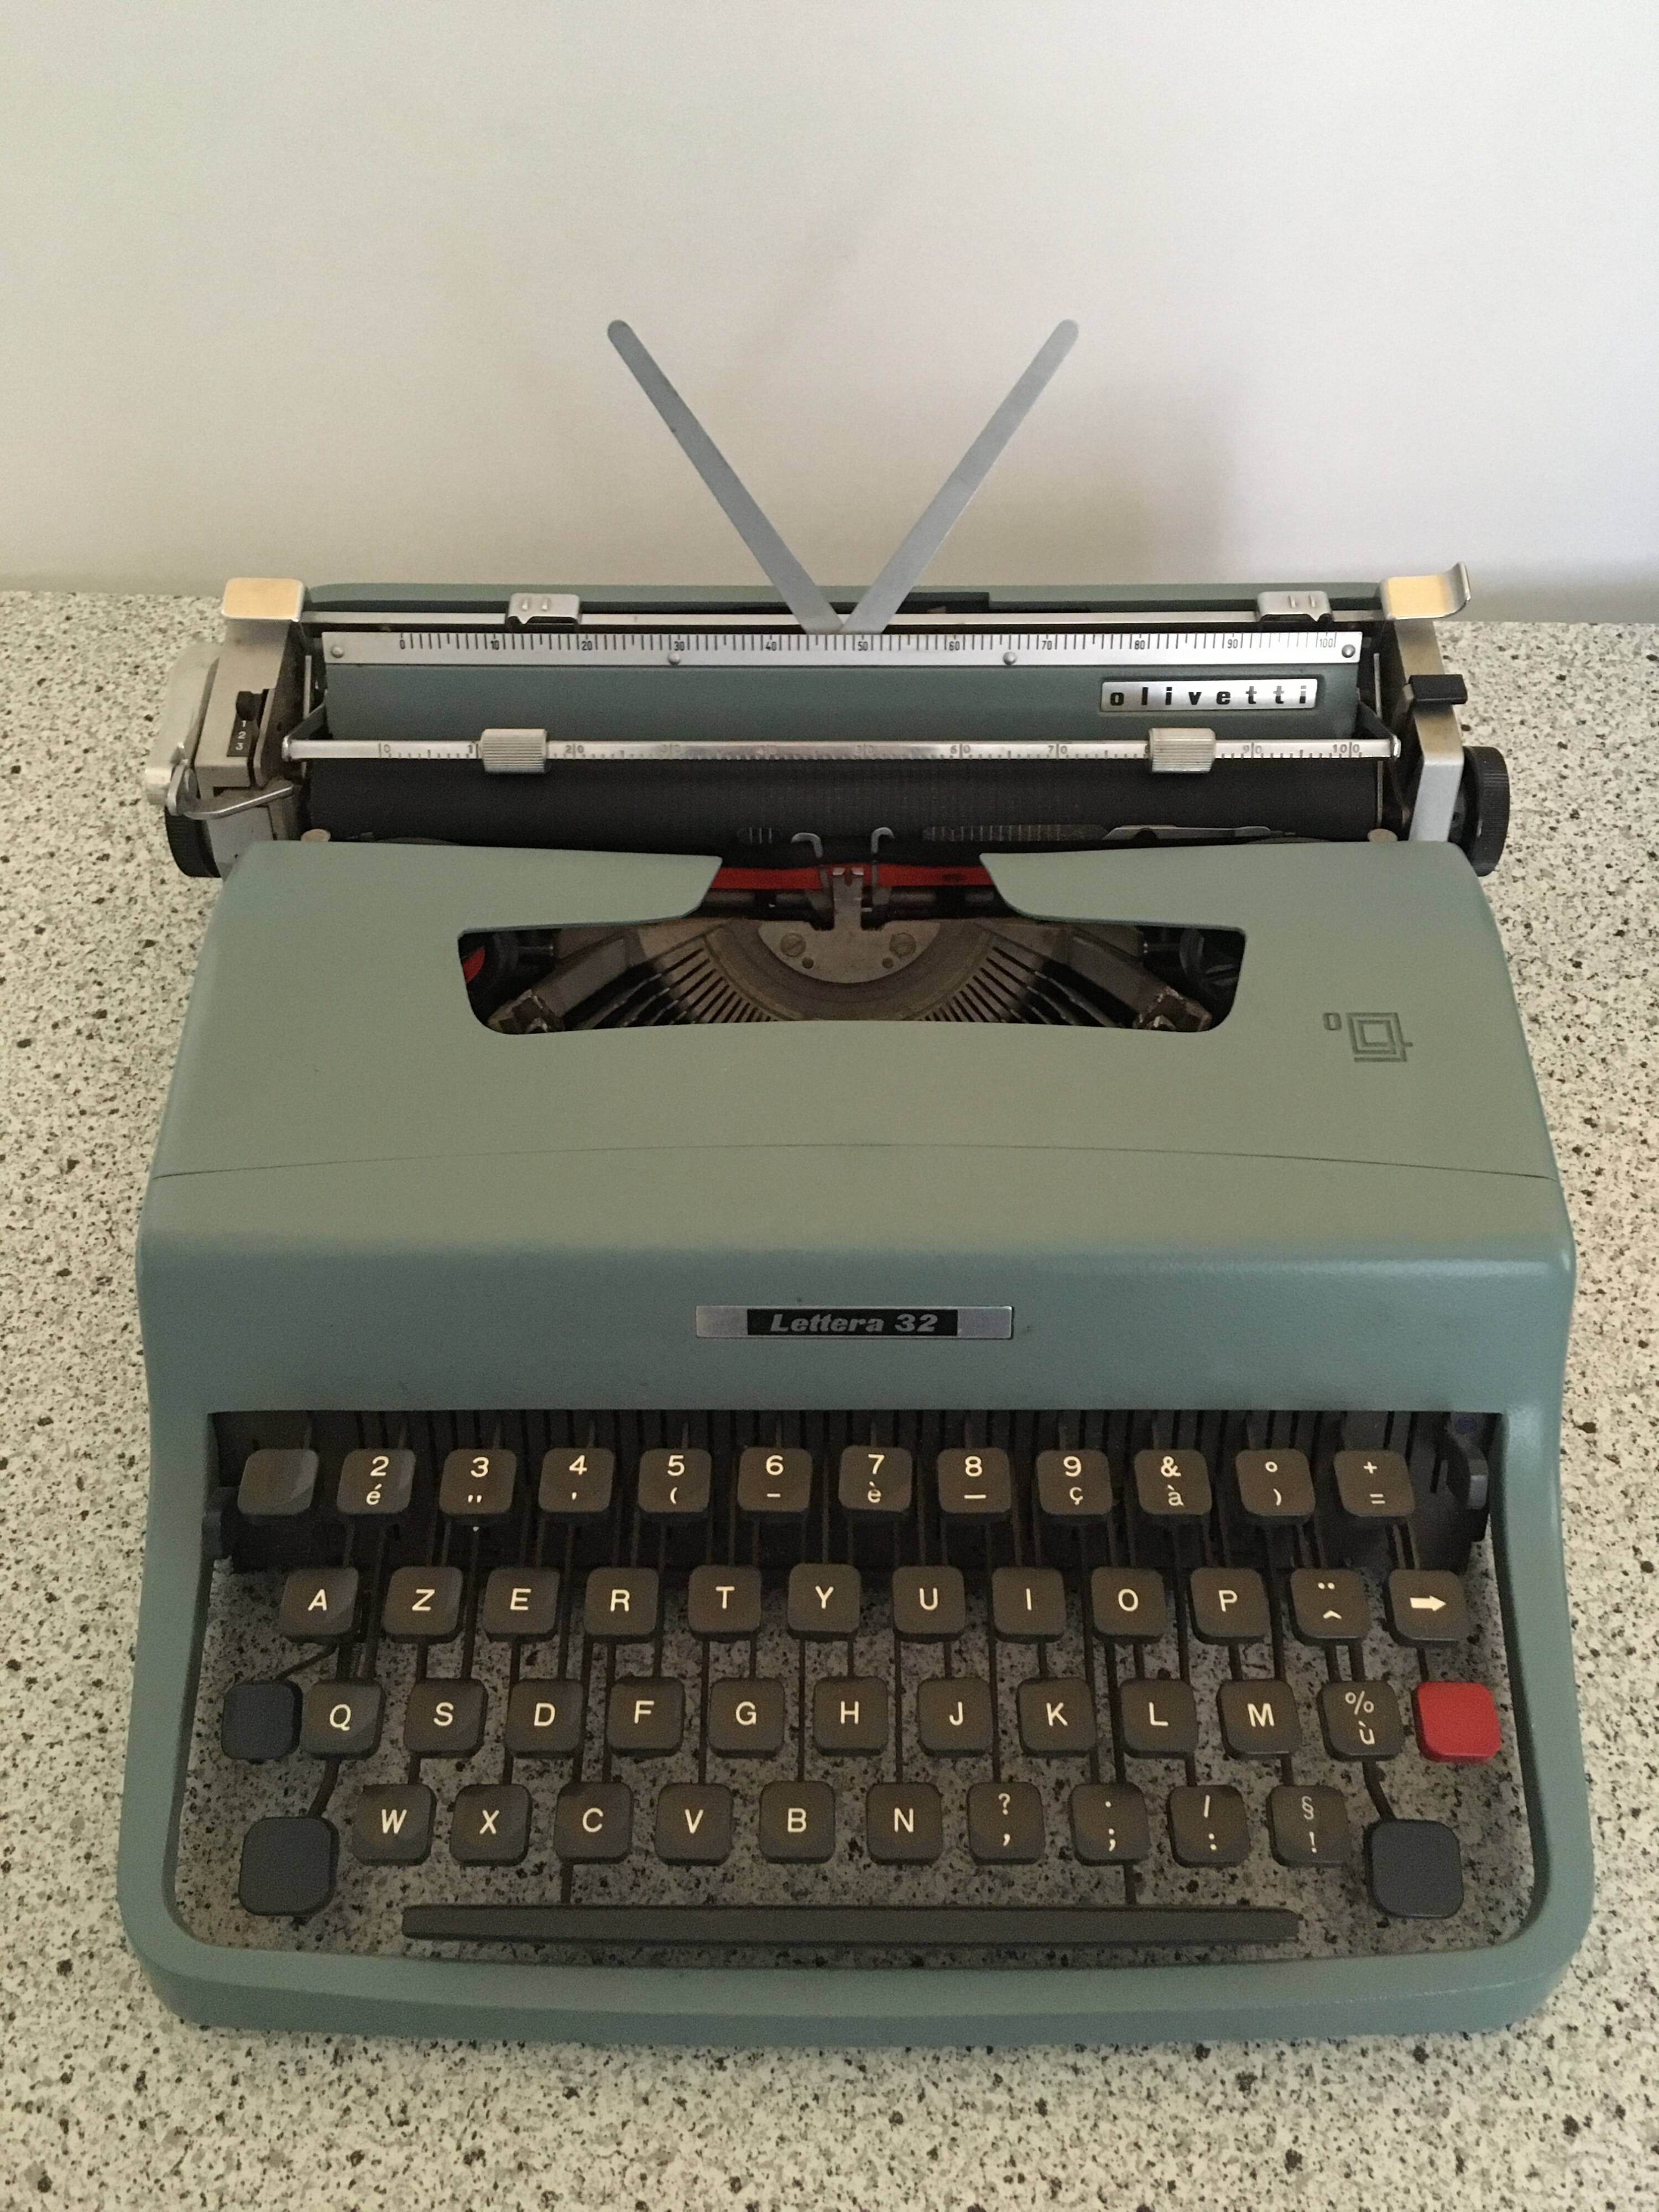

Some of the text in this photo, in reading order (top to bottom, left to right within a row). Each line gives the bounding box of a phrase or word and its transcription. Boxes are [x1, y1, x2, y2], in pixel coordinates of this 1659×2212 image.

[399, 638, 1333, 651] 0 10 20 30 40 50 60 70 80 90 100
[1110, 686, 1307, 706] olivetti
[242, 719, 247, 728] 1
[235, 742, 244, 750] 3
[237, 731, 247, 739] 2
[770, 1313, 938, 1333] Lettera 32
[370, 1455, 389, 1477] 2
[471, 1457, 489, 1478] 3
[569, 1455, 587, 1475] 4
[667, 1455, 685, 1477] 5
[766, 1455, 784, 1475] 6
[868, 1454, 885, 1474] 7
[965, 1456, 983, 1477] 8
[1063, 1456, 1082, 1477] 9
[1160, 1456, 1181, 1478] &
[1363, 1462, 1378, 1474] +
[366, 1484, 382, 1505] é
[670, 1487, 677, 1504] (
[867, 1481, 881, 1503] è
[1070, 1487, 1083, 1505] ç
[1167, 1484, 1184, 1506] à
[1273, 1489, 1282, 1506] )
[1369, 1494, 1385, 1504] =
[307, 1589, 327, 1611] A
[411, 1589, 435, 1611] Z
[510, 1588, 531, 1610] E
[610, 1589, 630, 1612] R
[716, 1586, 735, 1609] T
[815, 1586, 834, 1609] Y
[919, 1588, 938, 1610] U
[1026, 1588, 1032, 1610] I
[1118, 1589, 1139, 1611] O
[1218, 1590, 1238, 1612] P
[434, 1702, 453, 1726] S
[634, 1700, 655, 1724] F
[735, 1701, 757, 1725] G
[841, 1701, 859, 1724] H
[949, 1702, 963, 1725] J
[1046, 1702, 1068, 1726] K
[1149, 1702, 1168, 1726] L
[1345, 1691, 1374, 1715] %
[330, 1704, 351, 1731] Q
[534, 1703, 555, 1726] D
[1248, 1703, 1275, 1727] M
[1358, 1720, 1375, 1745] ù
[998, 1793, 1010, 1815] ?
[1203, 1795, 1210, 1818] /
[1302, 1796, 1314, 1820] §
[382, 1809, 407, 1834] W
[479, 1810, 499, 1834] X
[582, 1808, 603, 1833] C
[685, 1809, 703, 1834] V
[787, 1808, 807, 1833] B
[894, 1808, 914, 1833] N
[1003, 1834, 1010, 1846] ,
[1108, 1828, 1116, 1851] ;
[1208, 1833, 1217, 1850] :
[1309, 1832, 1317, 1853] !
